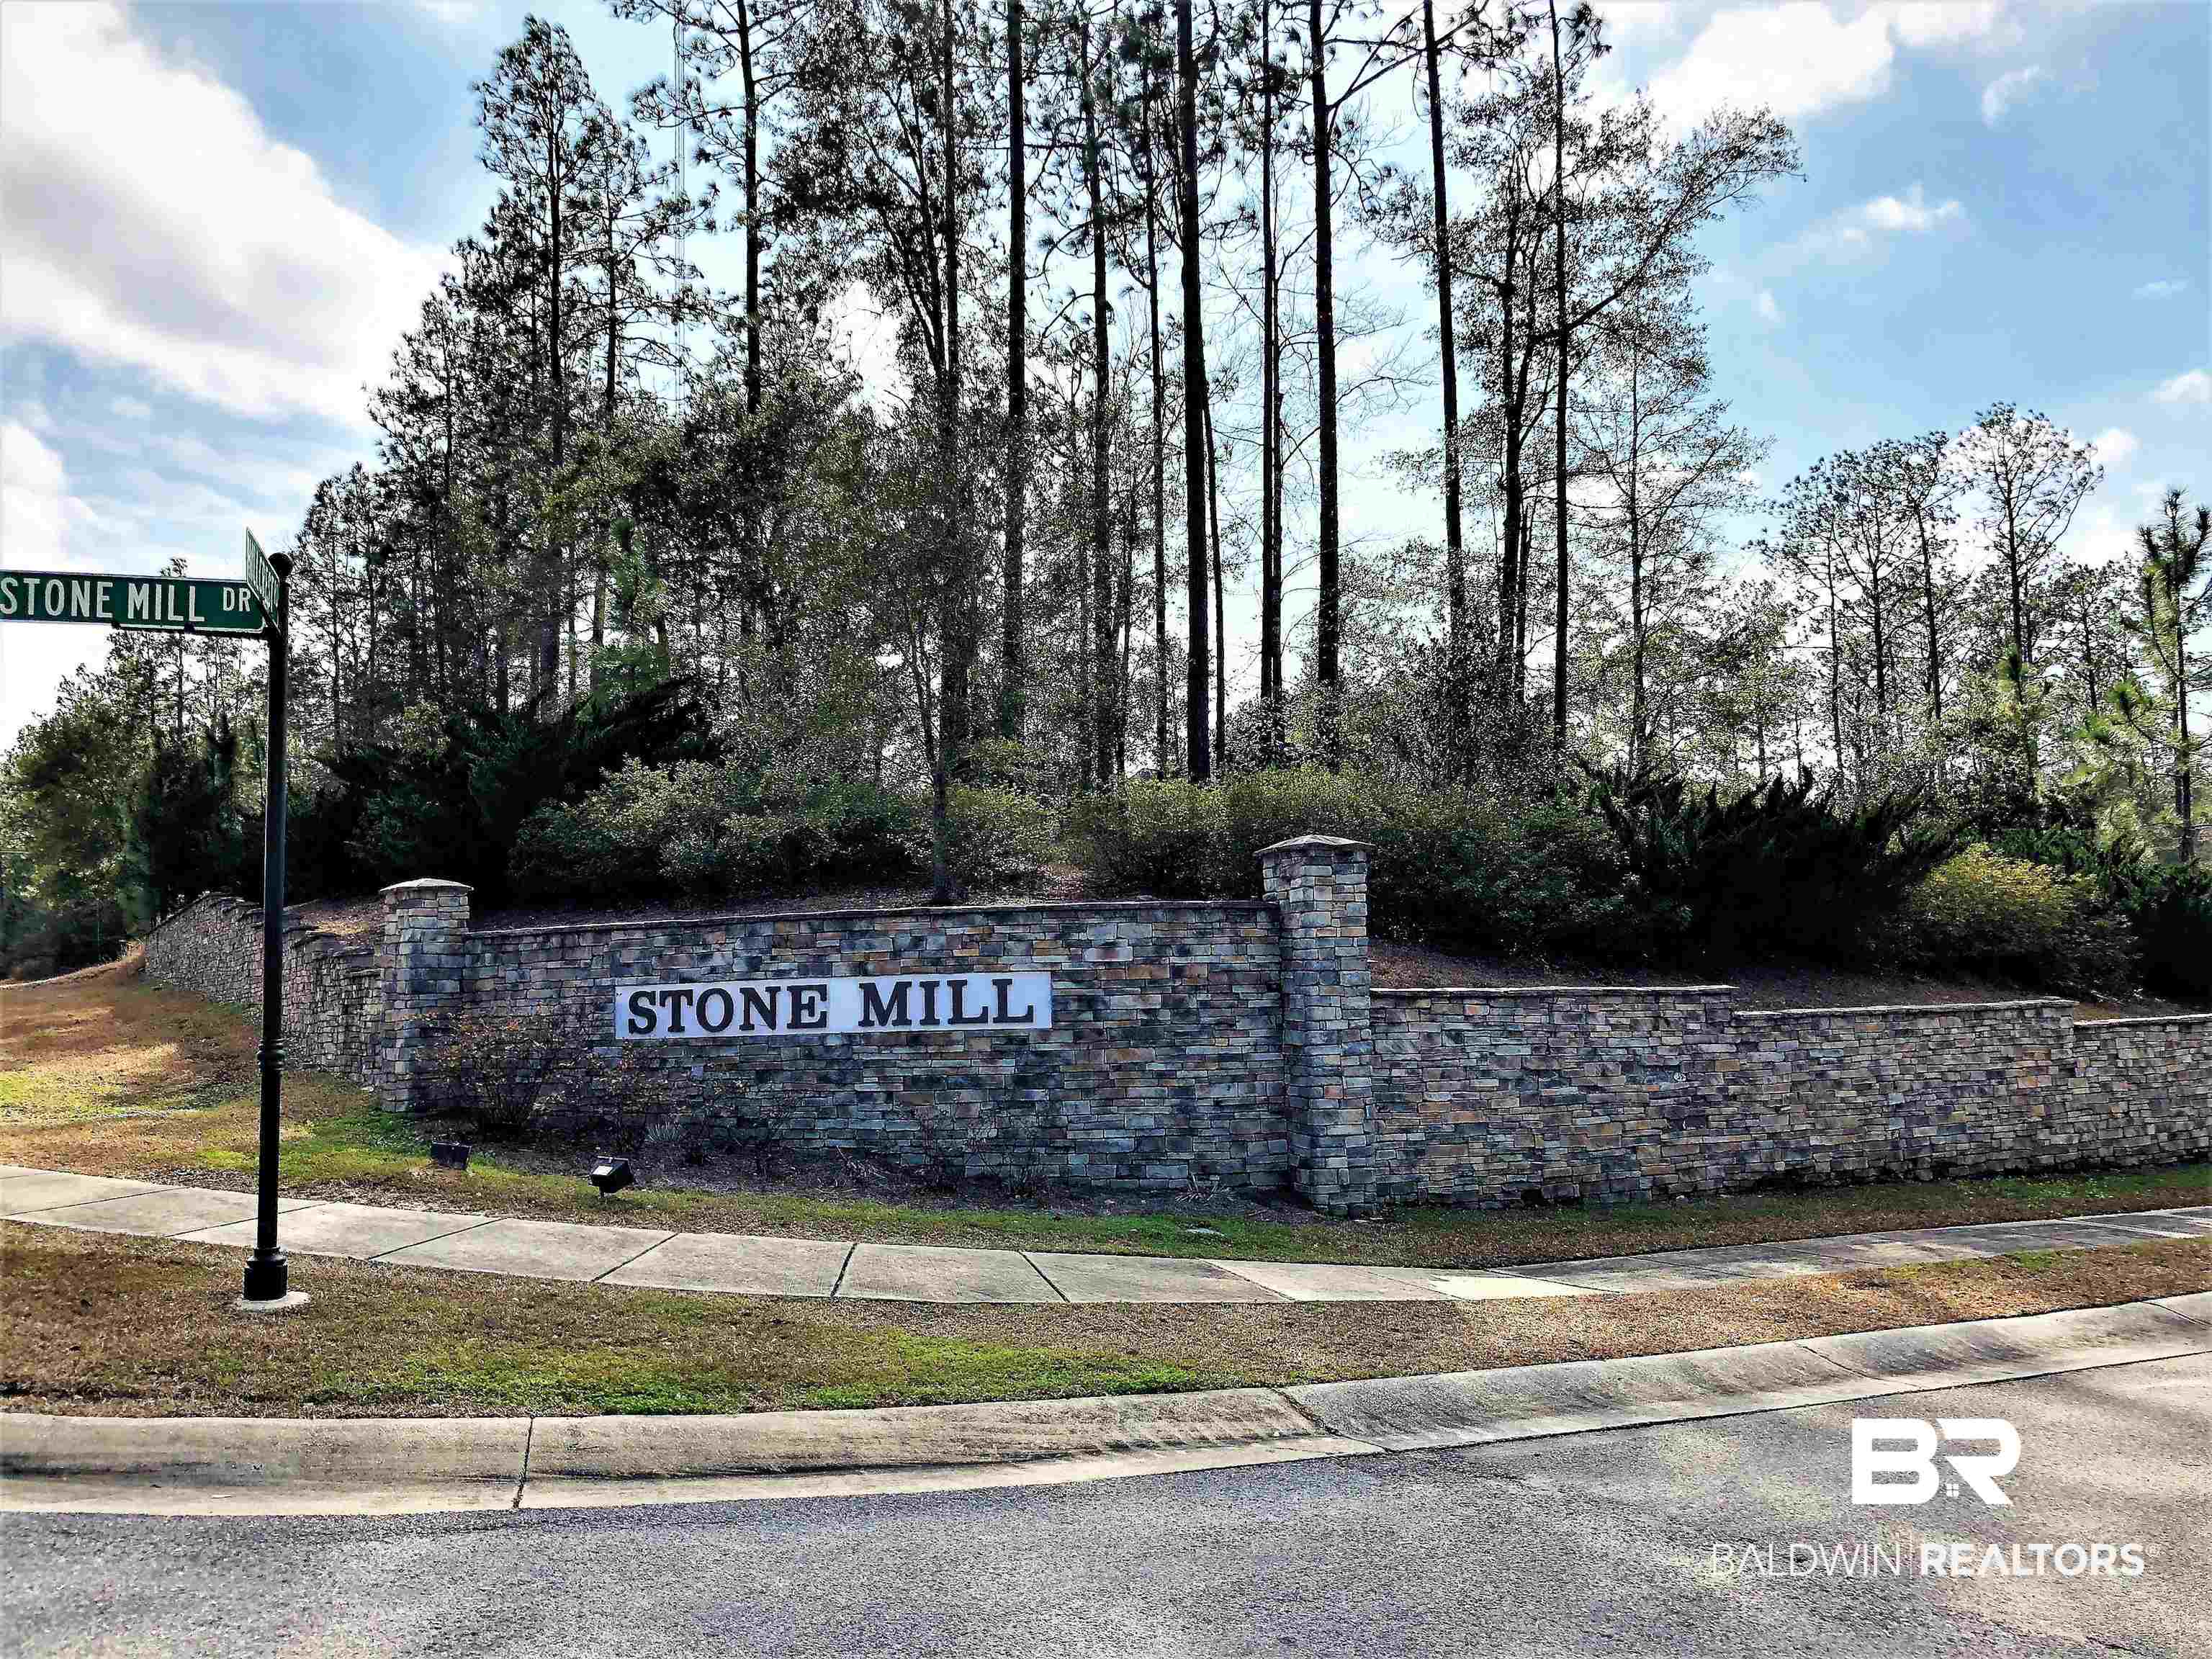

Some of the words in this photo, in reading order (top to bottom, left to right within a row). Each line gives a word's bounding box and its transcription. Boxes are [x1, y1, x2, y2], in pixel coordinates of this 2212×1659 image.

[0, 577, 114, 618] STONE
[127, 582, 205, 622] MILL
[222, 587, 251, 612] DR
[628, 984, 827, 1034] STONE
[858, 979, 1034, 1027] MILL
